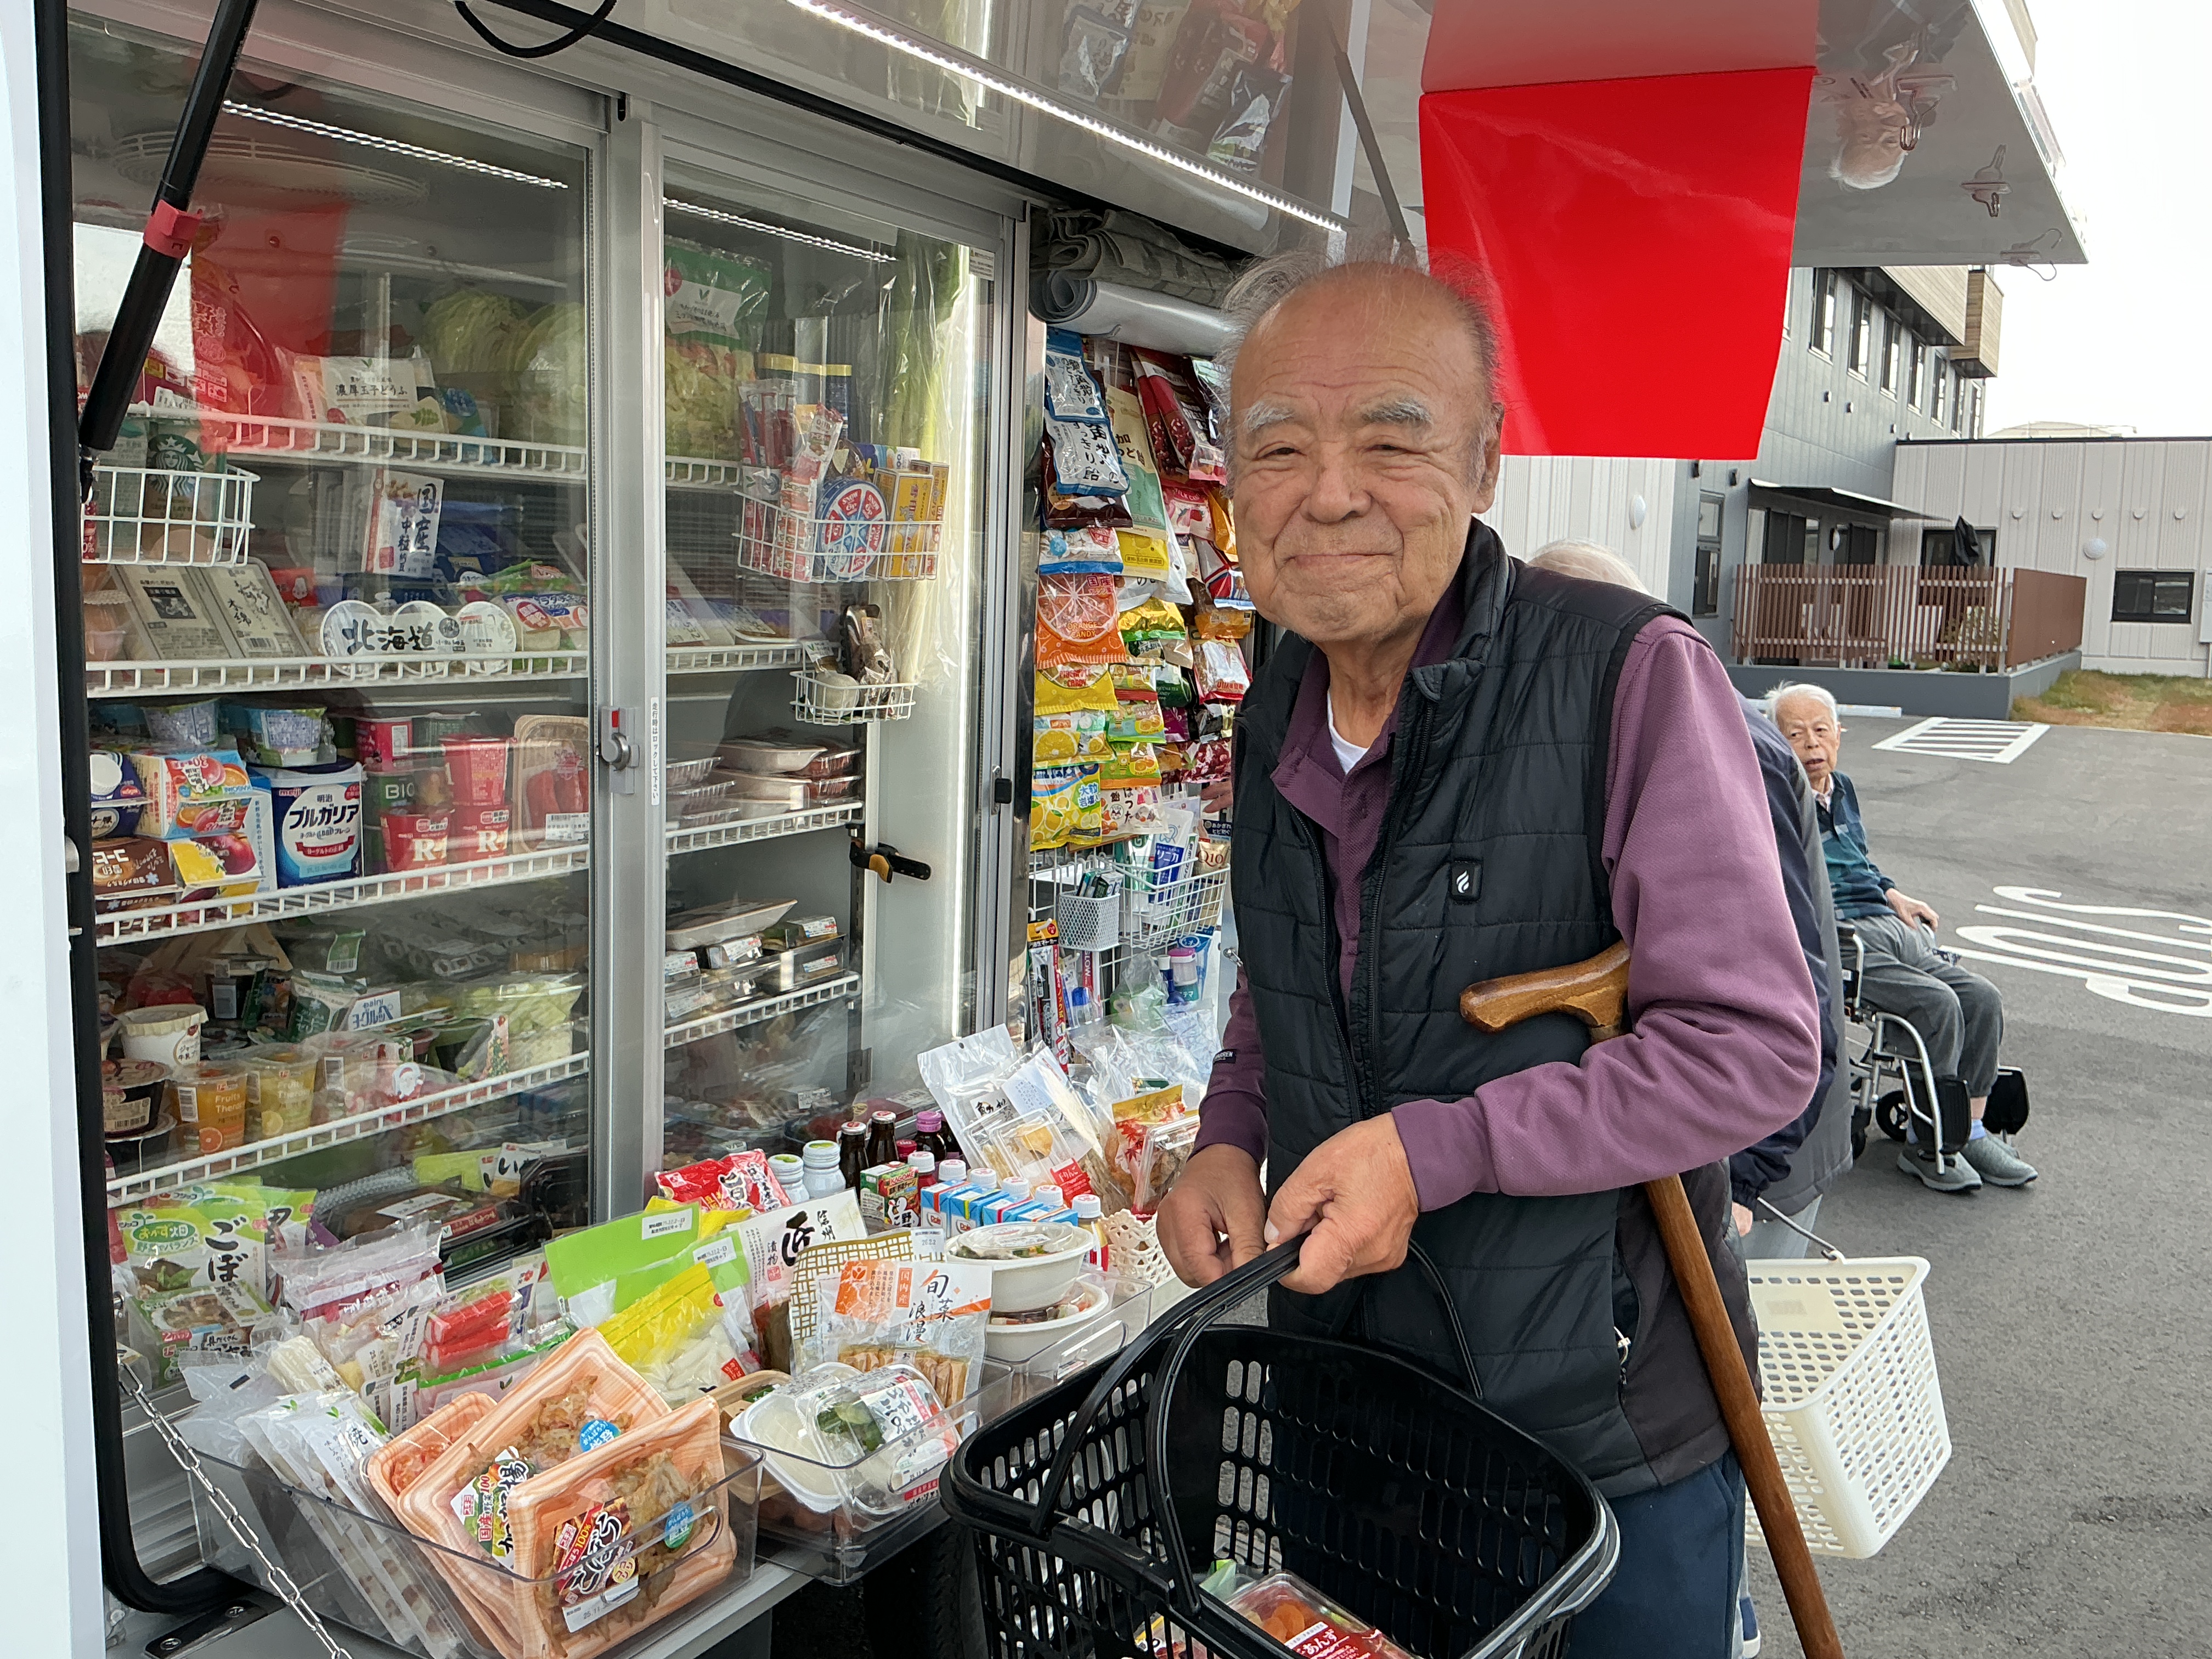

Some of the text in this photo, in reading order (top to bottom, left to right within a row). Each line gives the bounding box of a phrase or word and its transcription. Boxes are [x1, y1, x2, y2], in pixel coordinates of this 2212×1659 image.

[415, 483, 437, 551] 国産
[1087, 577, 1112, 587] 国産
[1067, 621, 1097, 630] ORANGE
[342, 619, 436, 655] 北海道
[1070, 630, 1096, 639] CANDY
[1067, 679, 1087, 687] CANDY
[317, 793, 333, 803] 明治
[289, 803, 359, 830] ブルガリア
[1196, 850, 1224, 867] Q10
[890, 1171, 915, 1186] KAGOME
[817, 1210, 836, 1241] 信州
[930, 1215, 941, 1225] Dole
[960, 1222, 971, 1232] Dole
[139, 1223, 189, 1239] おかず畑
[782, 1210, 815, 1267] 匠
[898, 1271, 910, 1305] 国内産
[919, 1269, 955, 1323] 旬菜
[906, 1300, 927, 1343] 浪漫
